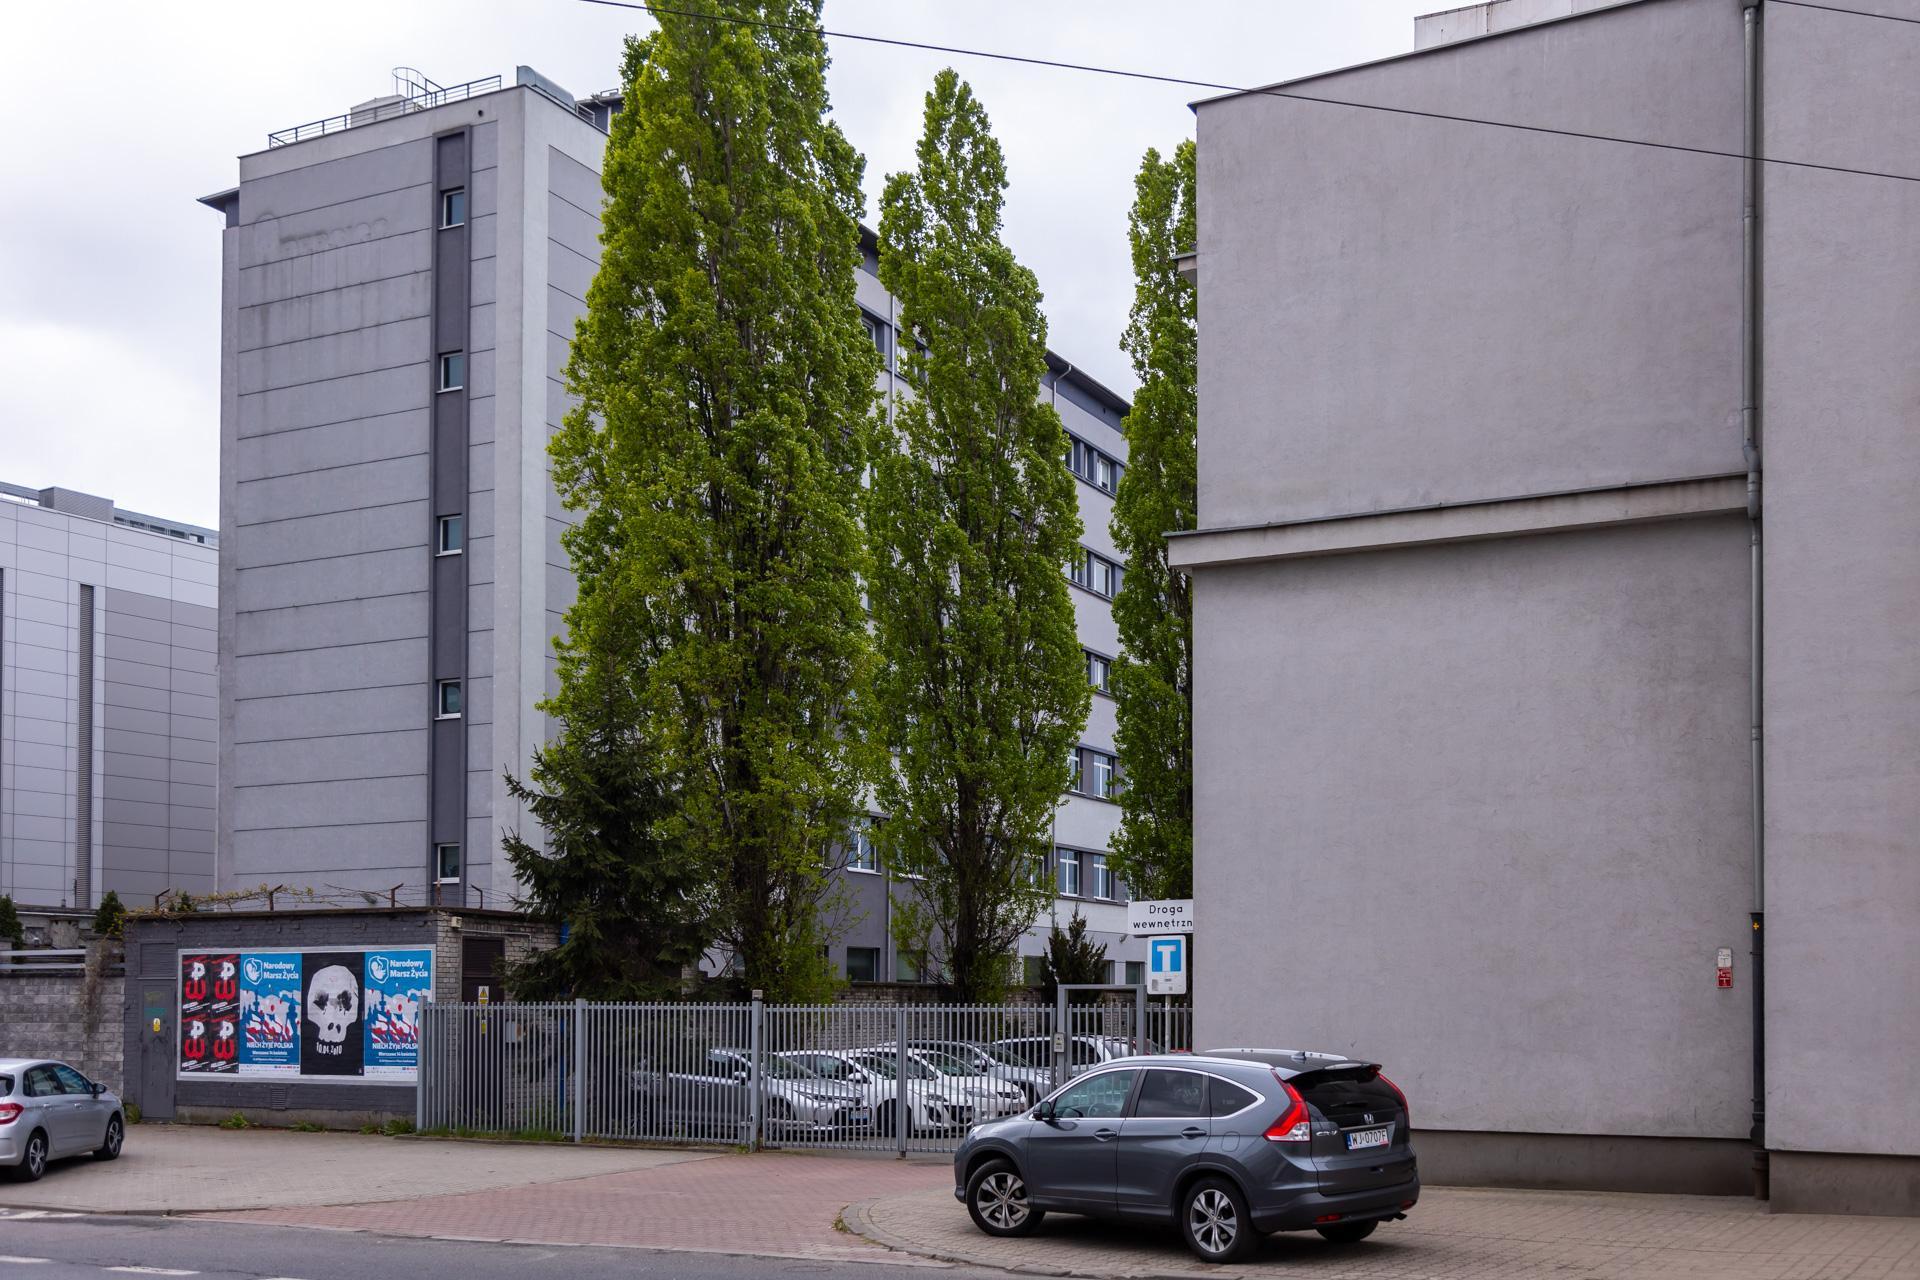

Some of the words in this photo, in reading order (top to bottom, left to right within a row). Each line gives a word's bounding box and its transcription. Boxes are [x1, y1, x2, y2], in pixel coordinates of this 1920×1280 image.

[1149, 904, 1183, 916] Droga
[1133, 918, 1193, 930] wewnętrzn
[263, 961, 295, 971] Narodowy
[390, 959, 424, 969] Narodowy
[263, 971, 282, 979] Marsz
[283, 969, 299, 981] Życia
[390, 969, 410, 977] Marsz
[411, 967, 428, 979] Życia
